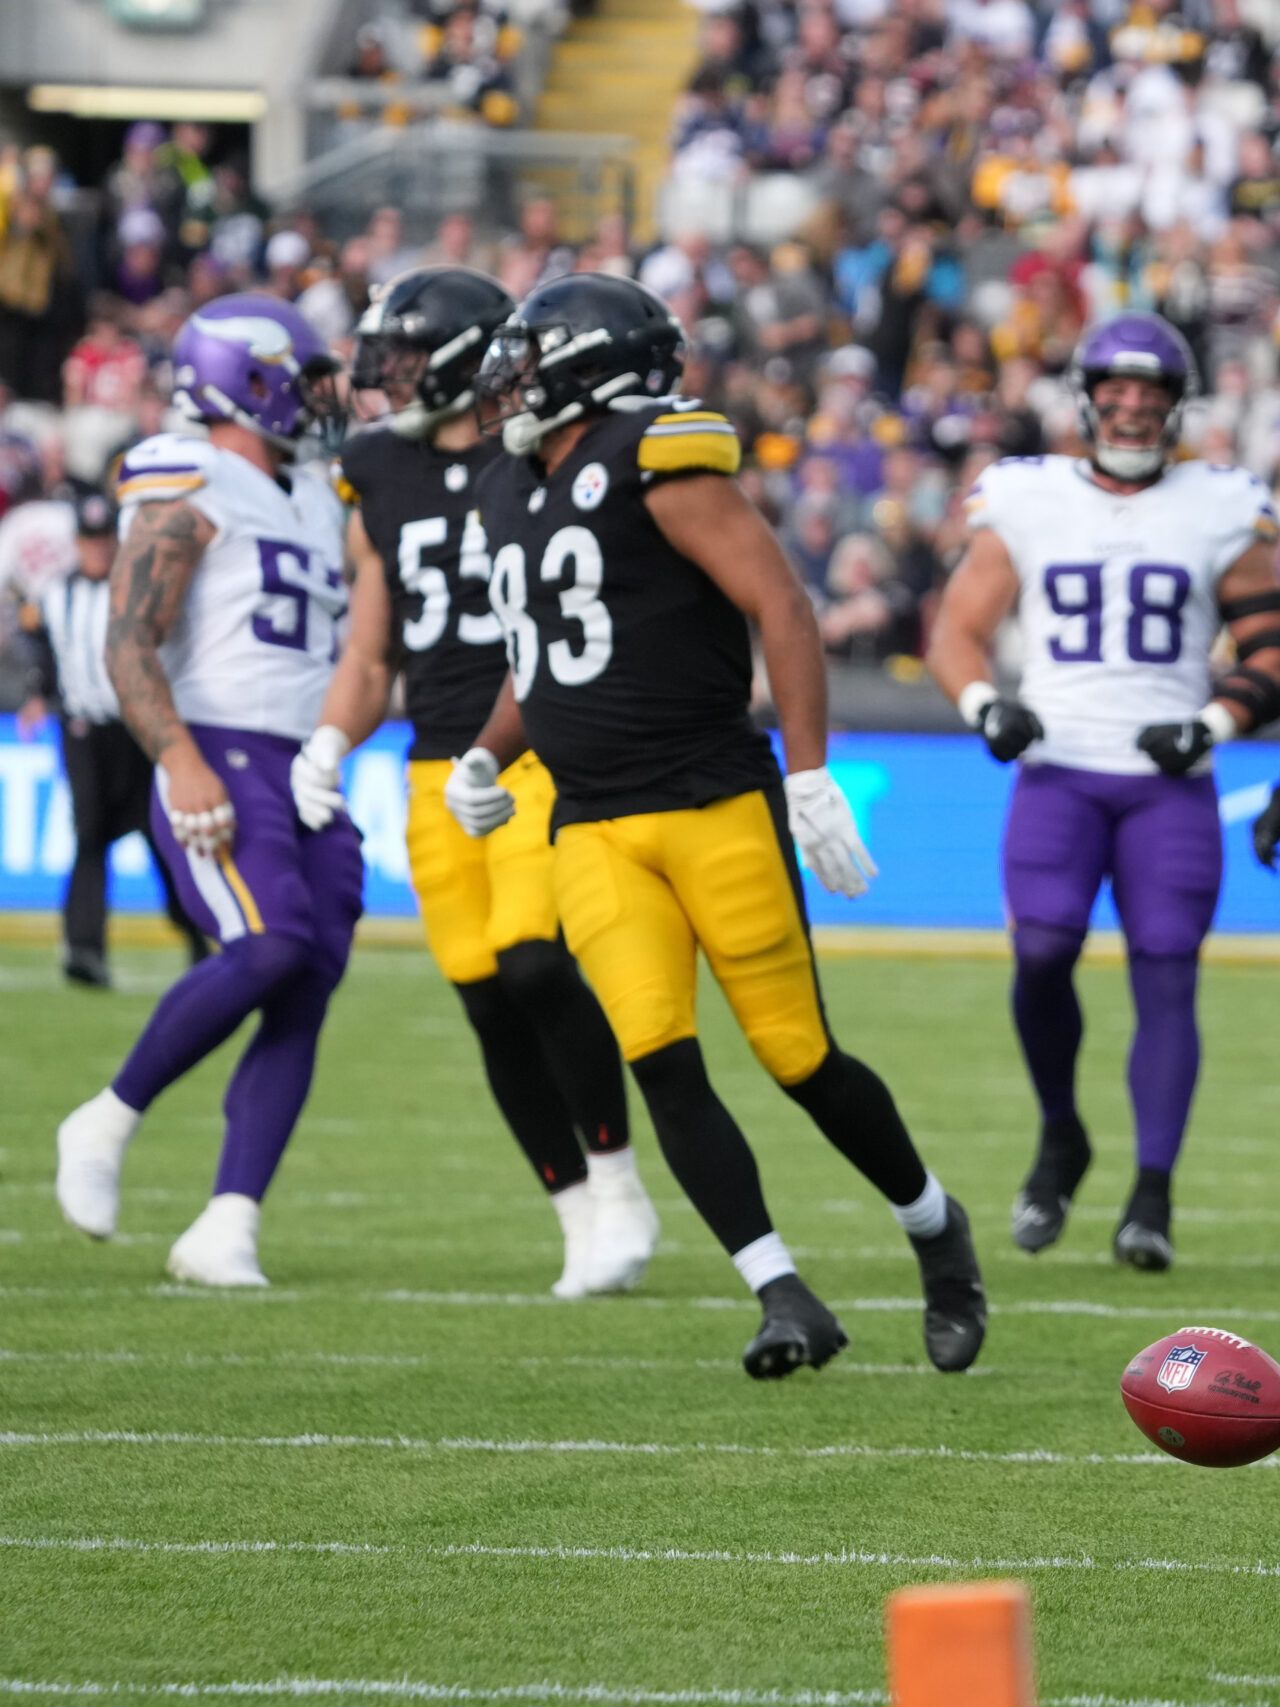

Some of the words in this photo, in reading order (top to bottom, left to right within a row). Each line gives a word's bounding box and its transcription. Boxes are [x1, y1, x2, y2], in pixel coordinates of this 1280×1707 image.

[489, 524, 613, 701] 83
[1045, 562, 1191, 664] 98
[1161, 1360, 1190, 1385] NFL
